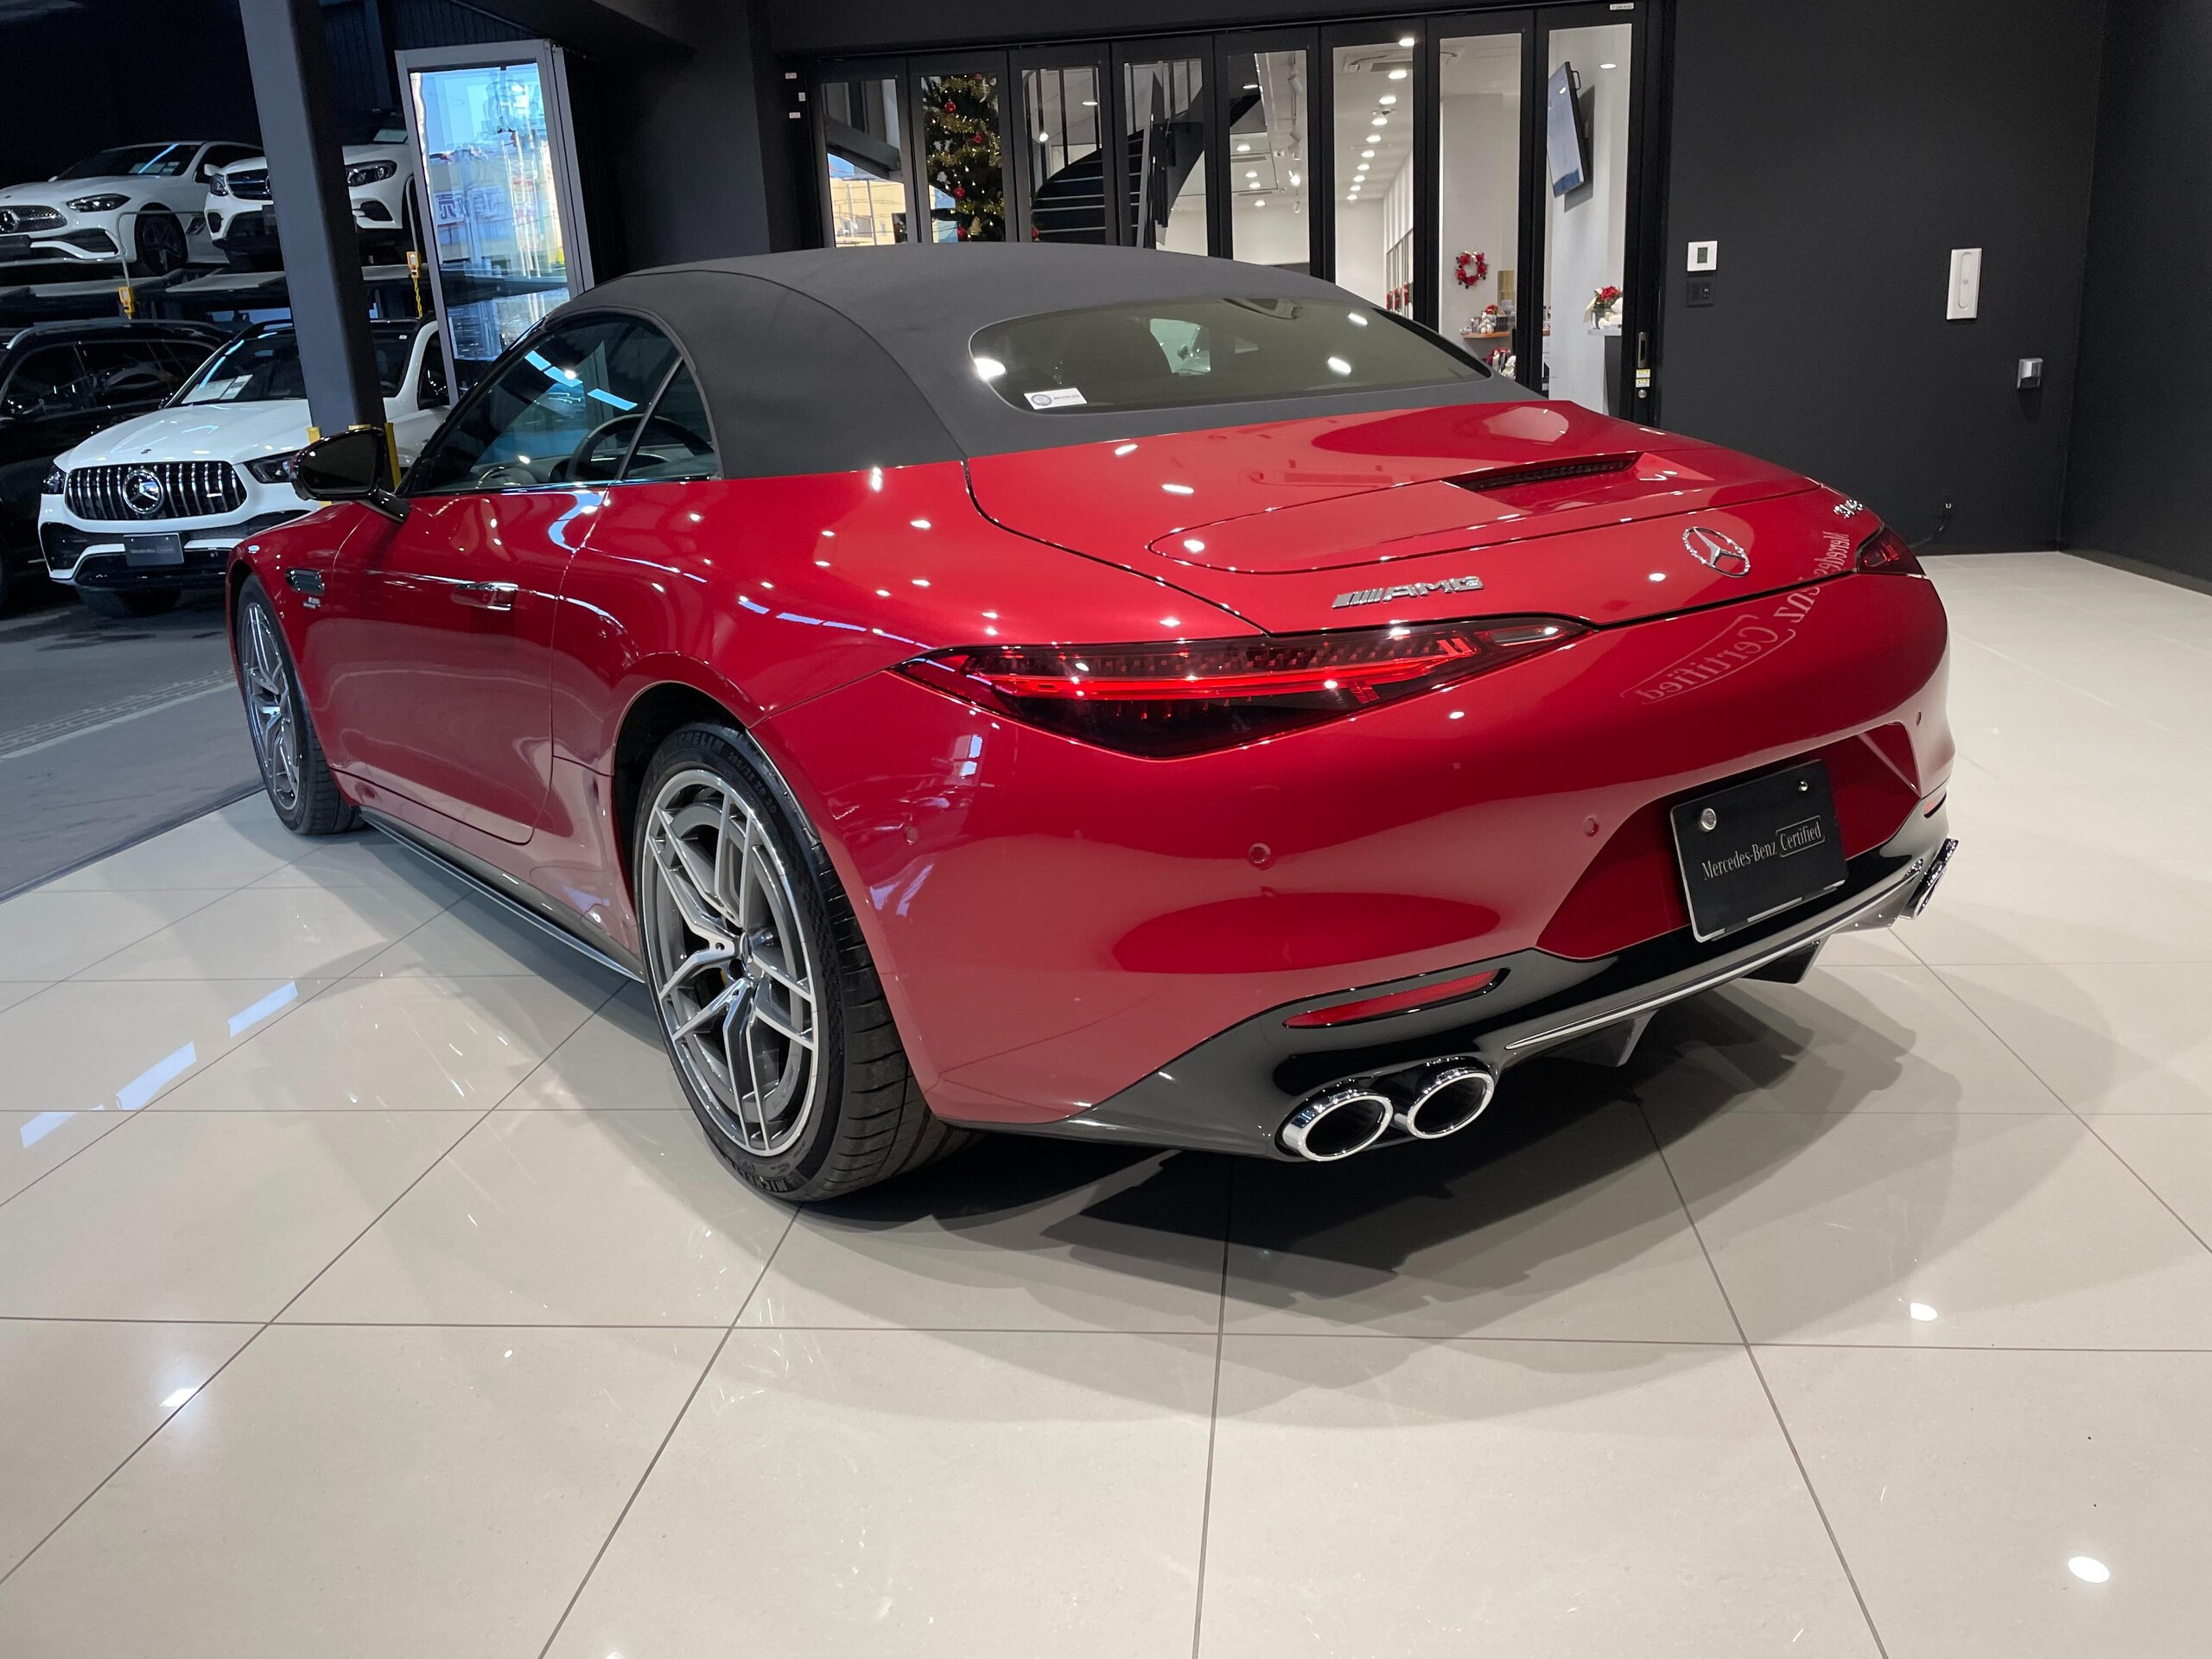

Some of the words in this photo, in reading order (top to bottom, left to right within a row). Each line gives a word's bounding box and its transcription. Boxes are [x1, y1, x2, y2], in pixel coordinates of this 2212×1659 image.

[1382, 575, 1484, 604] AMG
[1701, 842, 1777, 880] Mercedes-Benz
[1780, 822, 1821, 851] Certified
